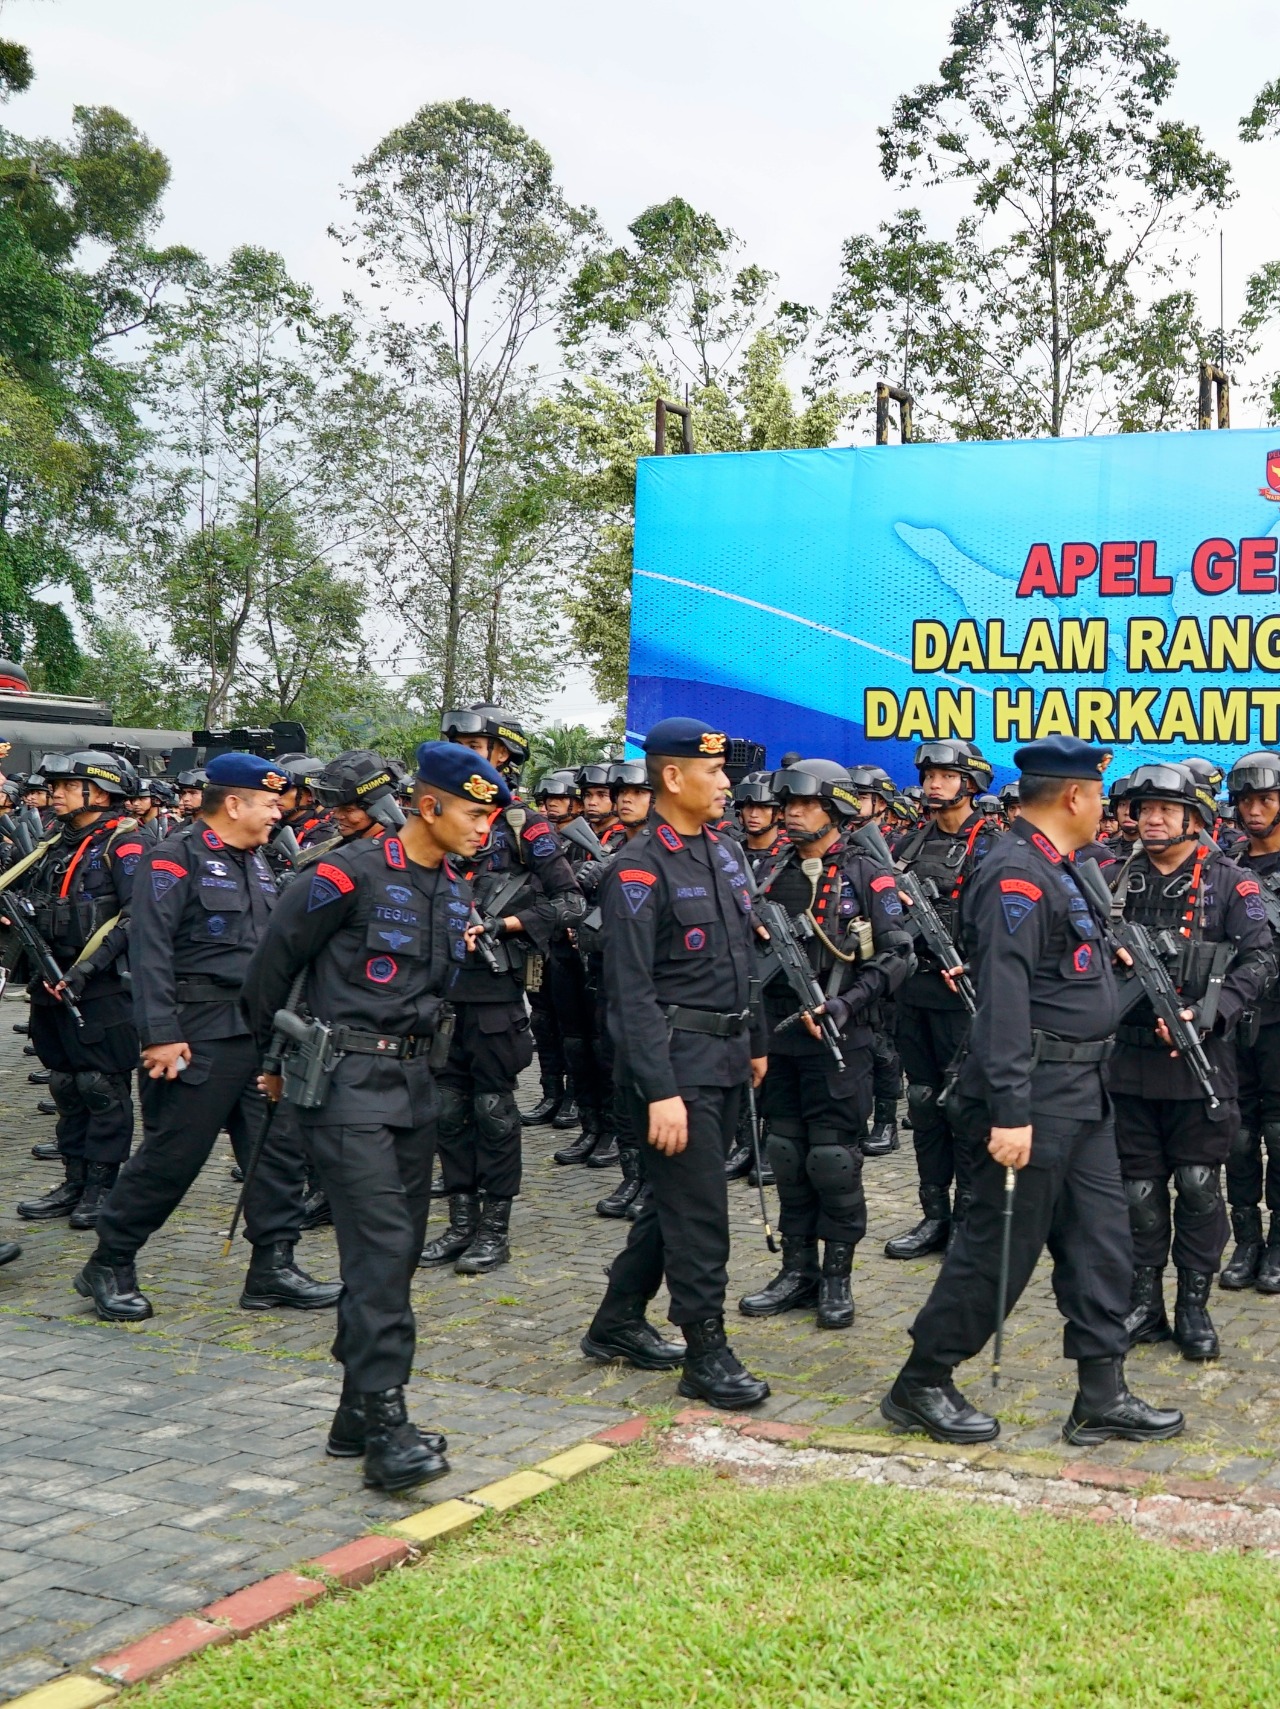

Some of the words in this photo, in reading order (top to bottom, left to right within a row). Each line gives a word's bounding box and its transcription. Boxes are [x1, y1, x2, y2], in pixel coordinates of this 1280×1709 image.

[1016, 541, 1173, 598] APEL
[912, 617, 1107, 673] DALAM
[865, 687, 975, 741] DAN
[86, 765, 121, 784] BRIMOB
[356, 773, 391, 795] BRIMOB
[375, 905, 417, 924] TEGUH
